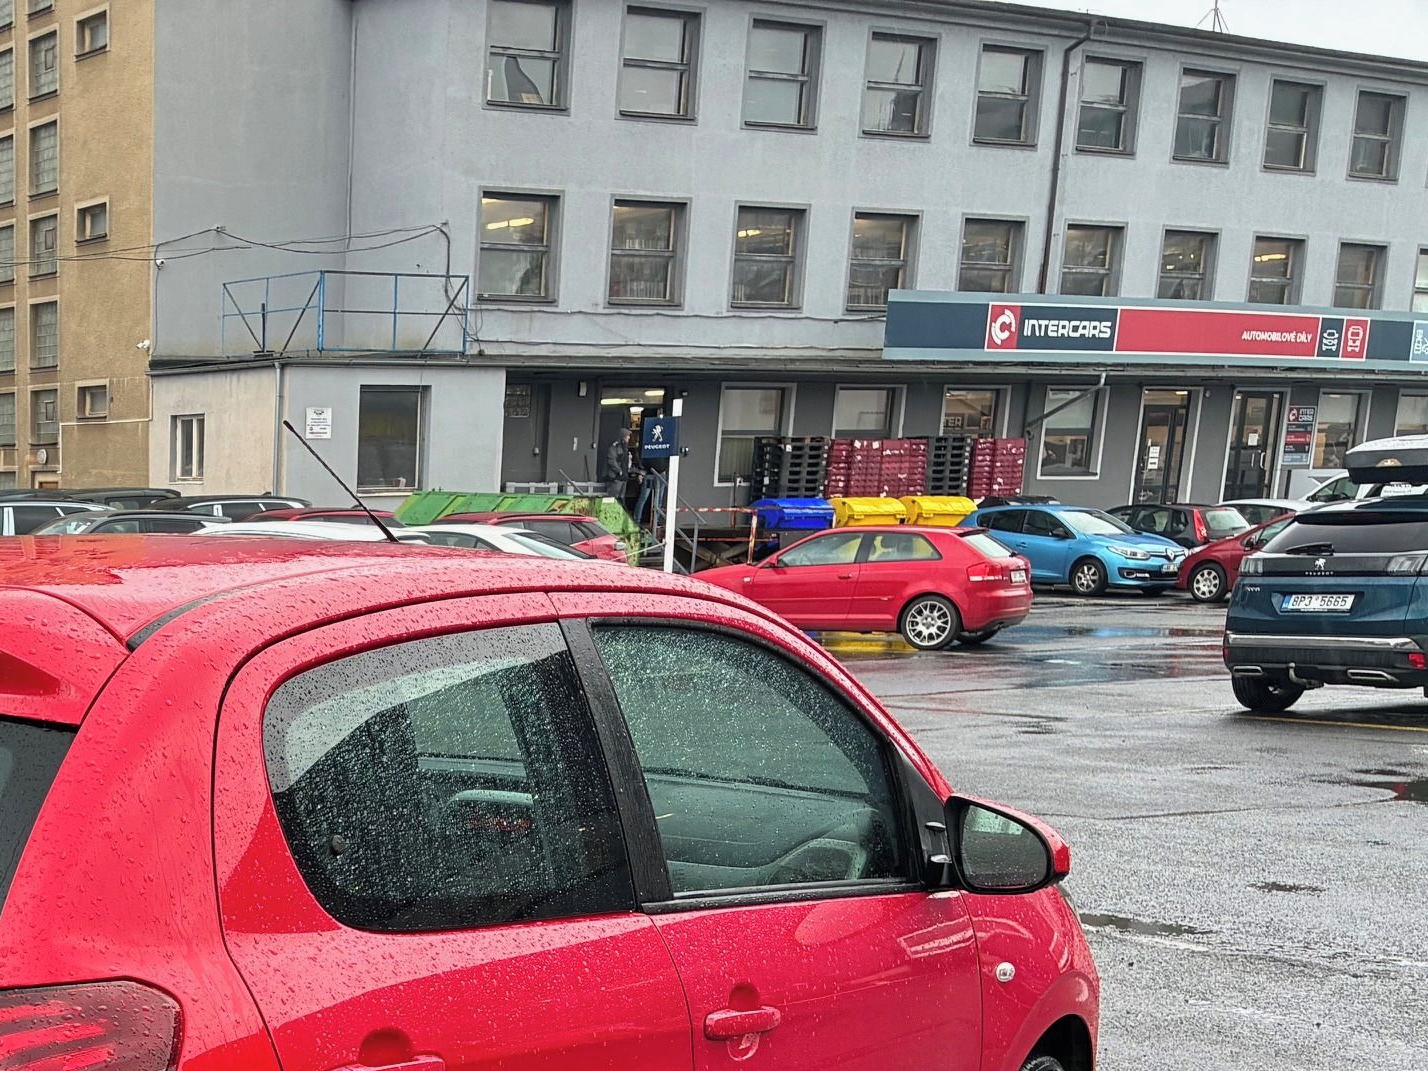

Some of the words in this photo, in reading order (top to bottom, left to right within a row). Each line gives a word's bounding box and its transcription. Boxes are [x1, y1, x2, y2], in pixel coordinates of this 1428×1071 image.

[1023, 319, 1112, 338] INTERCARS
[1241, 330, 1296, 342] AUTOMOBILOVÉ
[1296, 331, 1312, 343] DÍLY
[1291, 595, 1313, 607] 8P3
[1319, 595, 1349, 607] 5665
